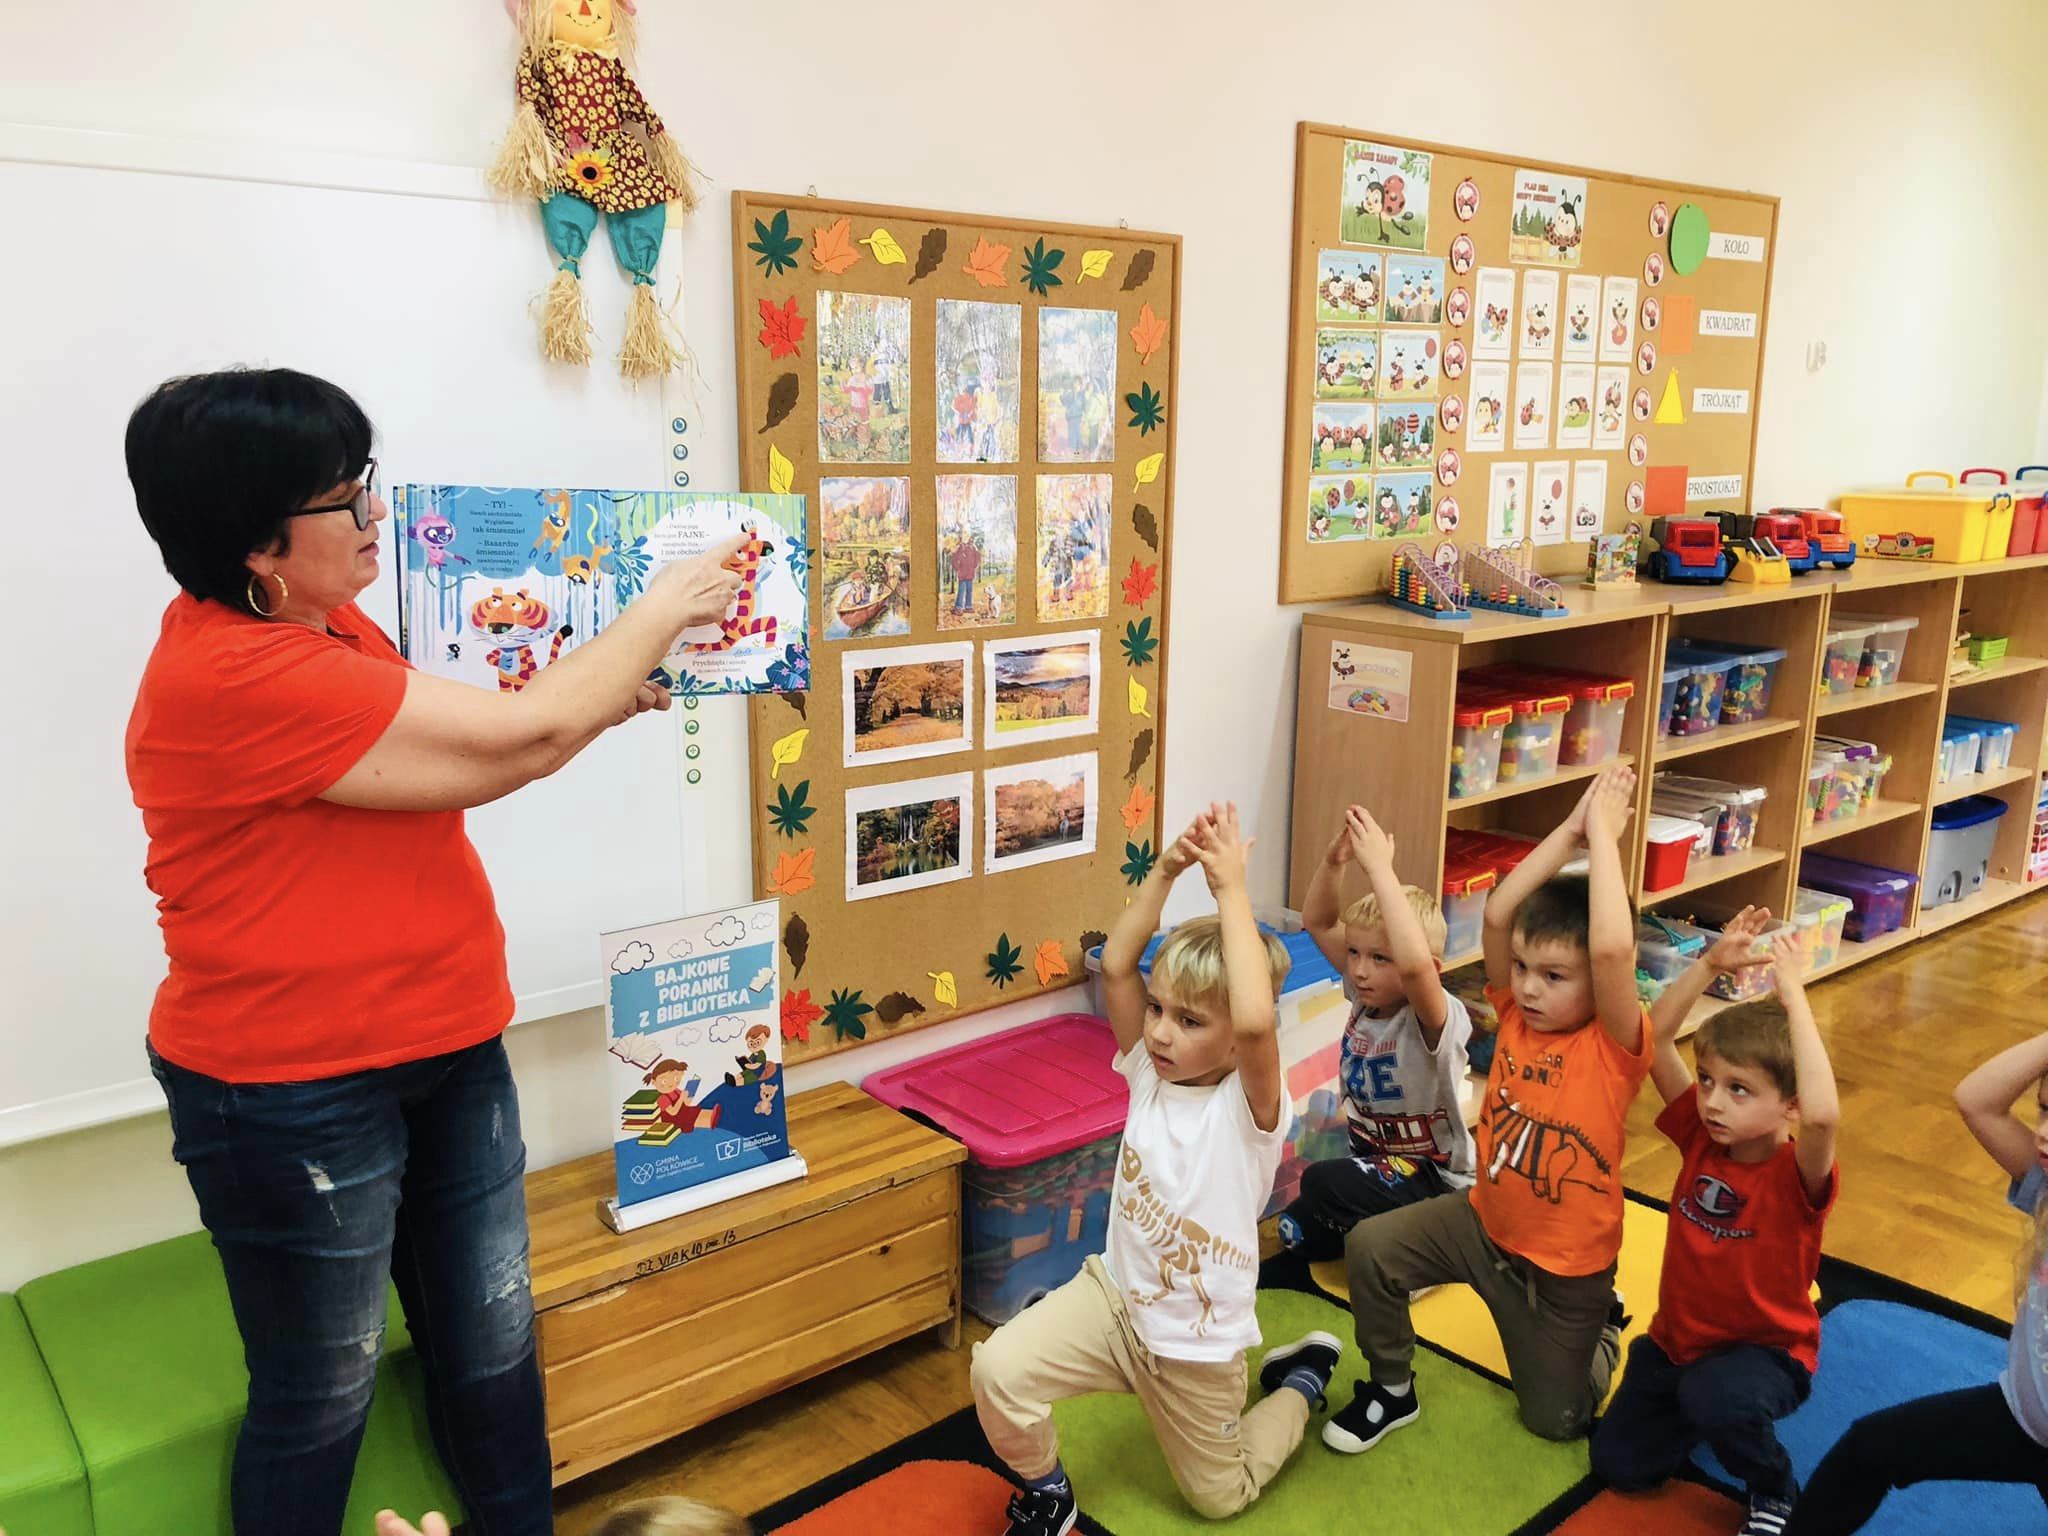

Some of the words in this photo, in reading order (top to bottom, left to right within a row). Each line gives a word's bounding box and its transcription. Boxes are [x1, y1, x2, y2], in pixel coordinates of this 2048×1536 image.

[1705, 316, 1751, 331] KWADRAT
[654, 955, 731, 987] BAJKOWE
[658, 973, 729, 1005] PORANKI
[639, 1010, 650, 1028] Z
